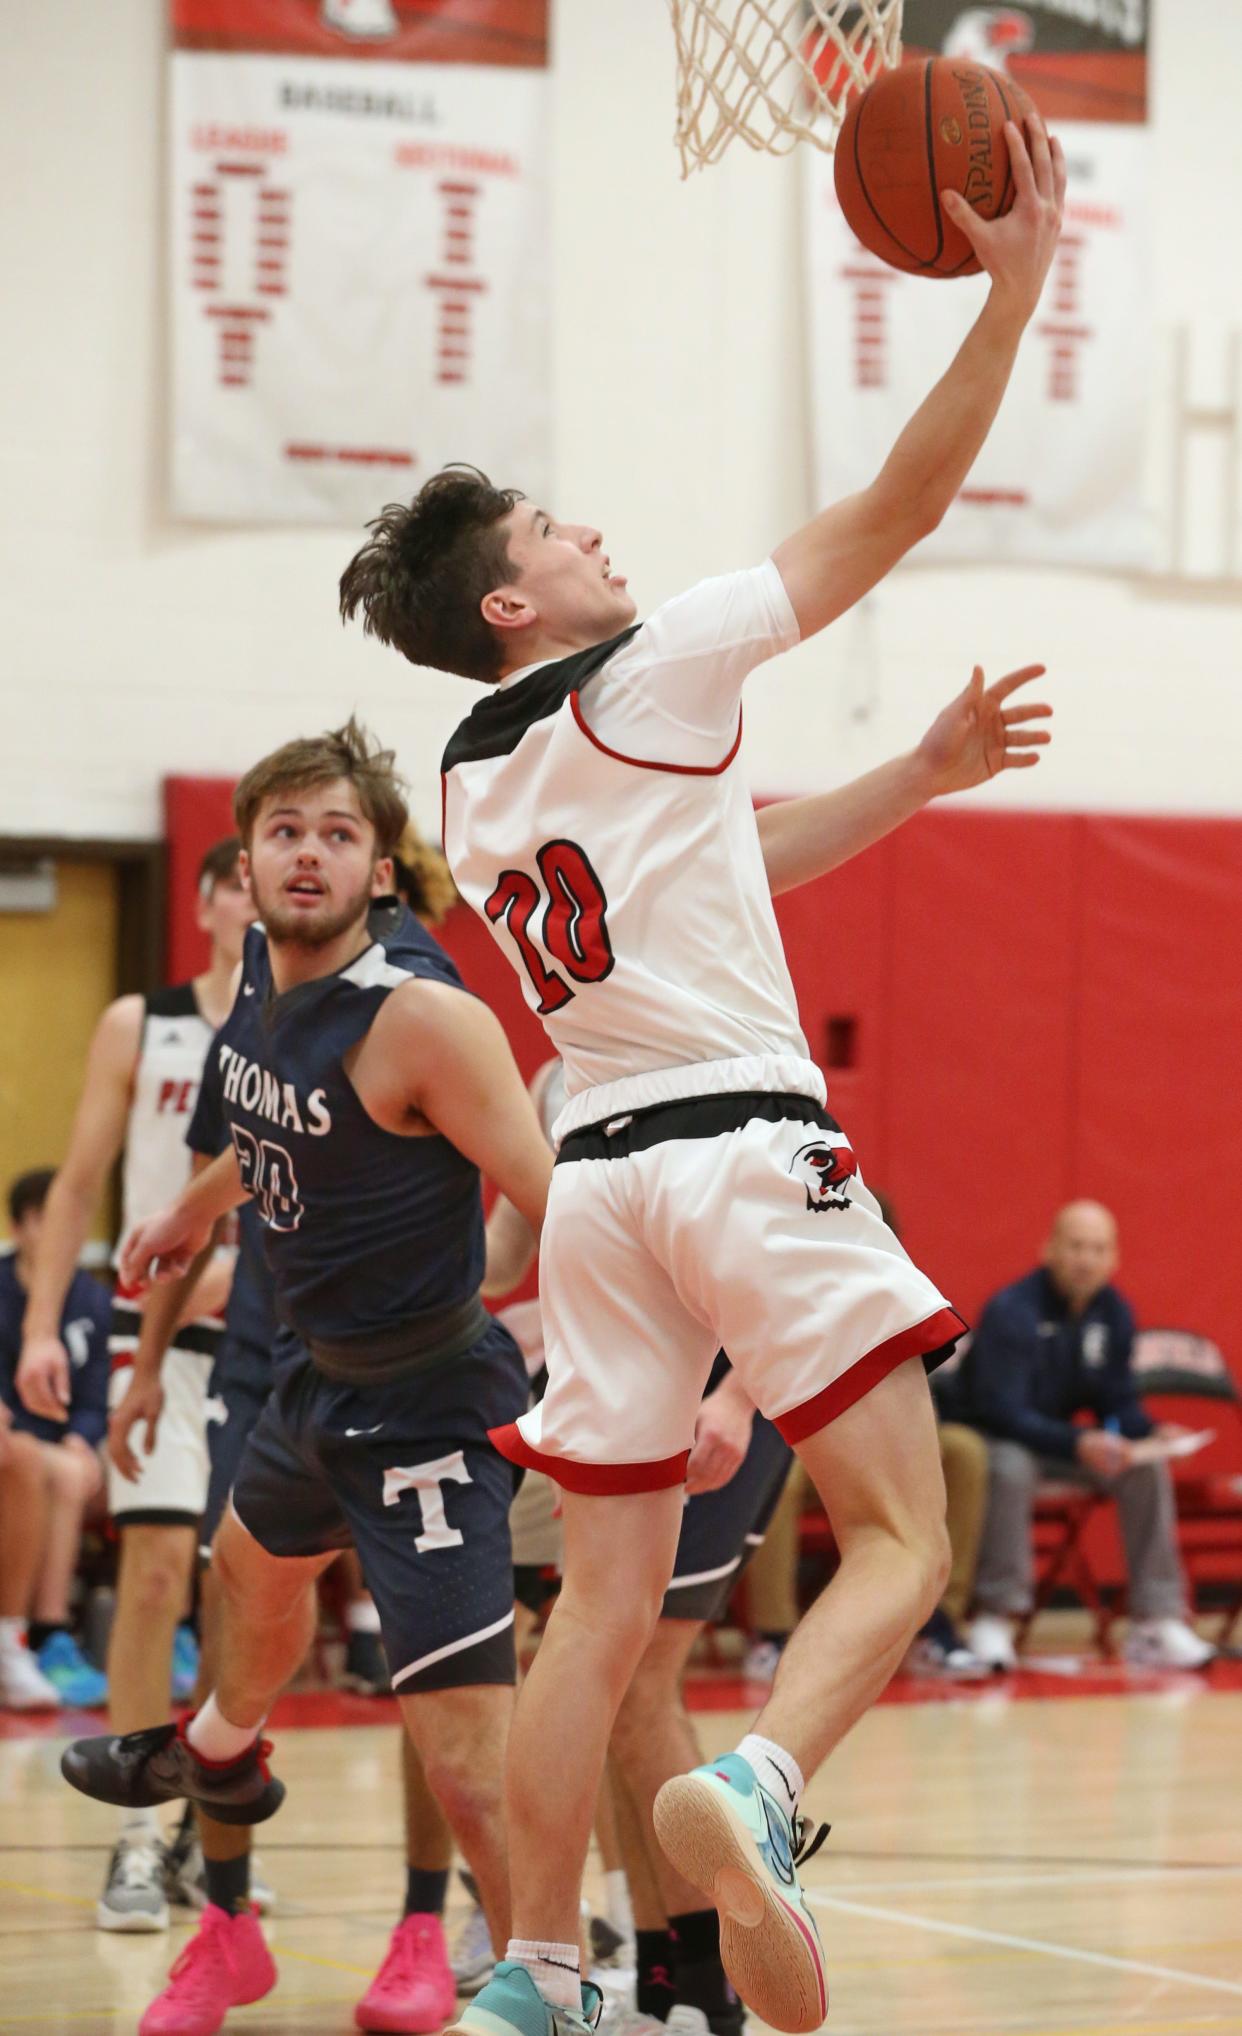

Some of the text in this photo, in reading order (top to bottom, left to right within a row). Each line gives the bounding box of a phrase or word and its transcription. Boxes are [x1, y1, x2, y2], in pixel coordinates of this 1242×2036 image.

[279, 81, 440, 126] BASEBALL
[952, 67, 993, 209] SPALDING
[218, 1043, 332, 1137] THOMAS
[382, 1449, 475, 1554] T
